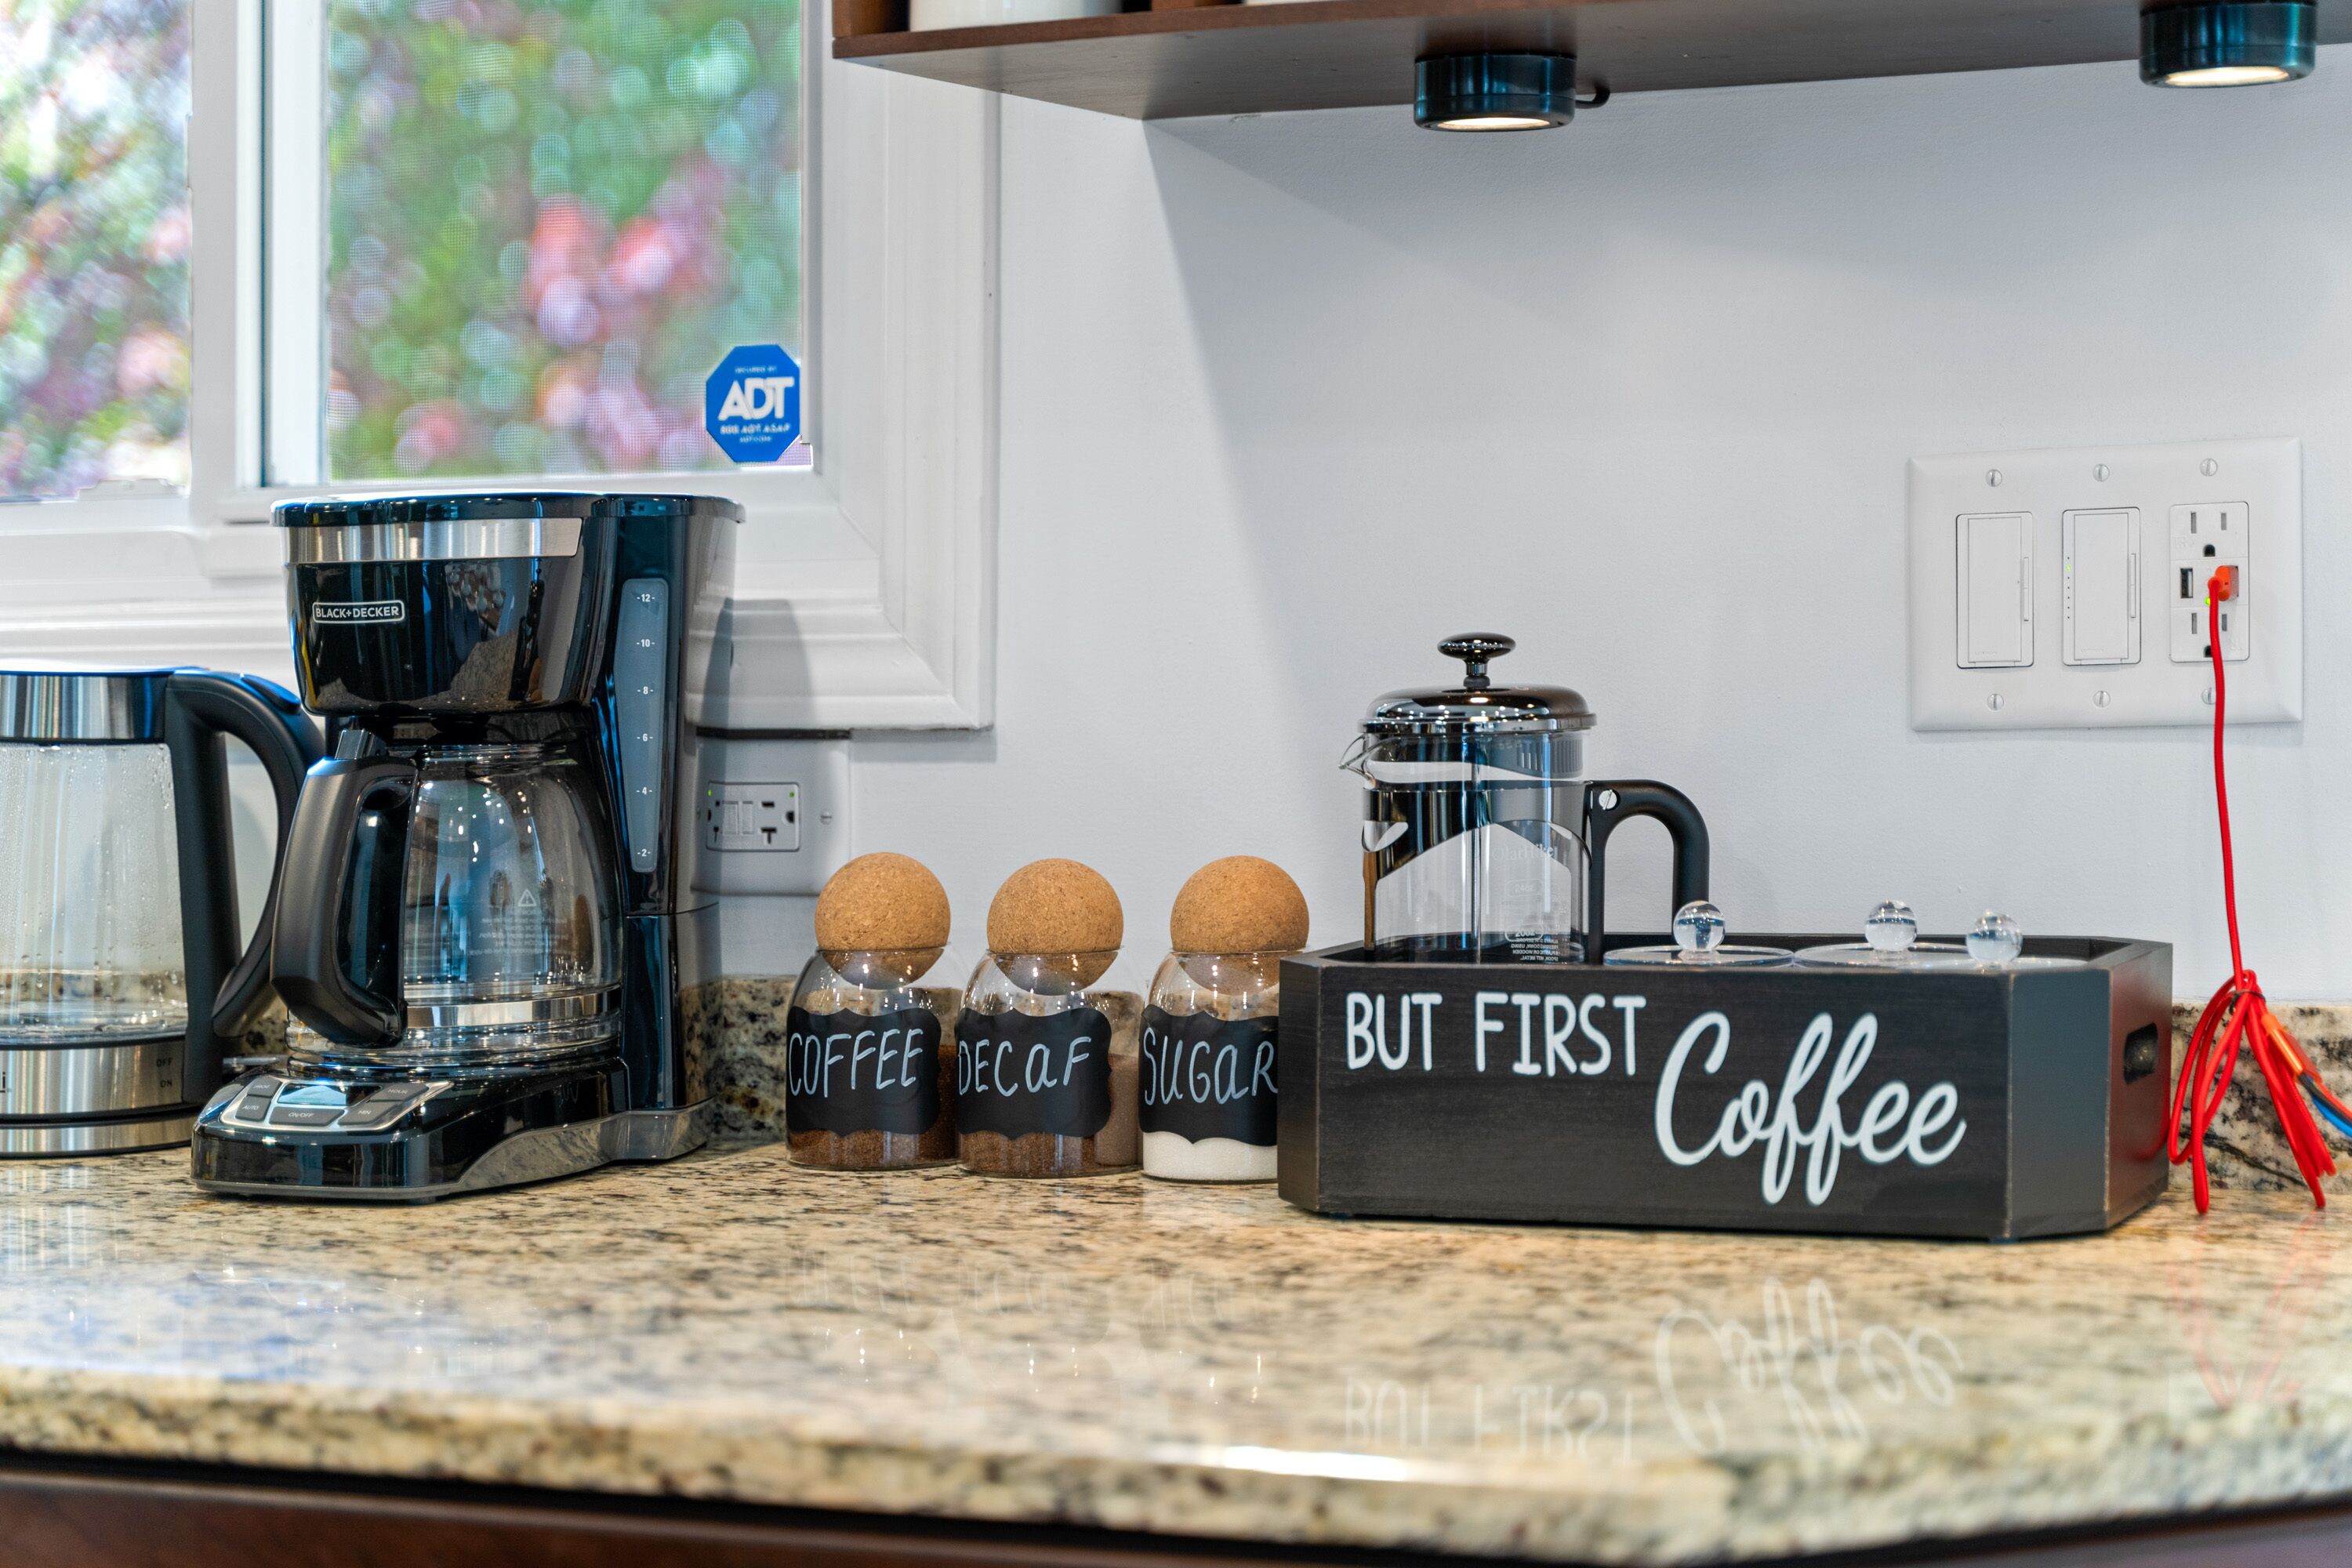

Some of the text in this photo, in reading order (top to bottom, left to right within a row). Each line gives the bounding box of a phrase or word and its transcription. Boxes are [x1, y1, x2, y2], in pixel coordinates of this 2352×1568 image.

[718, 377, 795, 421] ADT
[315, 606, 399, 619] BLACK+DECKER
[789, 1029, 923, 1098] COFFEE
[1346, 991, 1967, 1206] BUT FIRST Coffee
